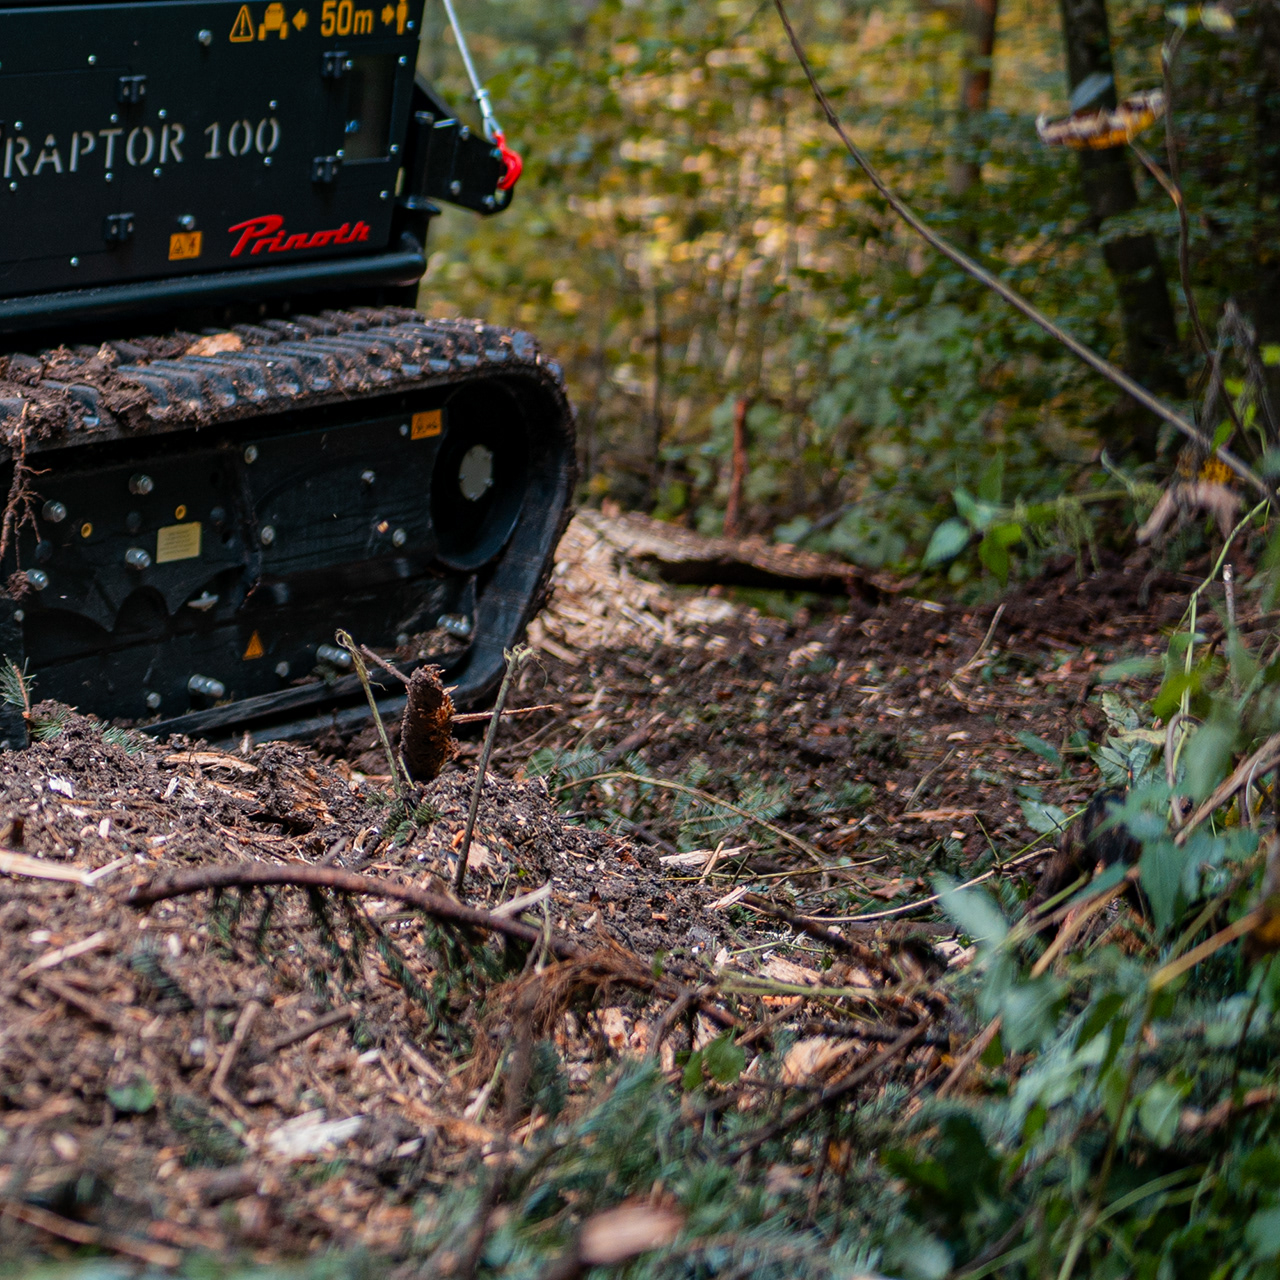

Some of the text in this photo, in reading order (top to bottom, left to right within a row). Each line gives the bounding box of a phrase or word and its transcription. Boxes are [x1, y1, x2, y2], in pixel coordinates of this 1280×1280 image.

[3, 118, 280, 178] RAPTOR 100
[228, 214, 370, 257] Prinoth
